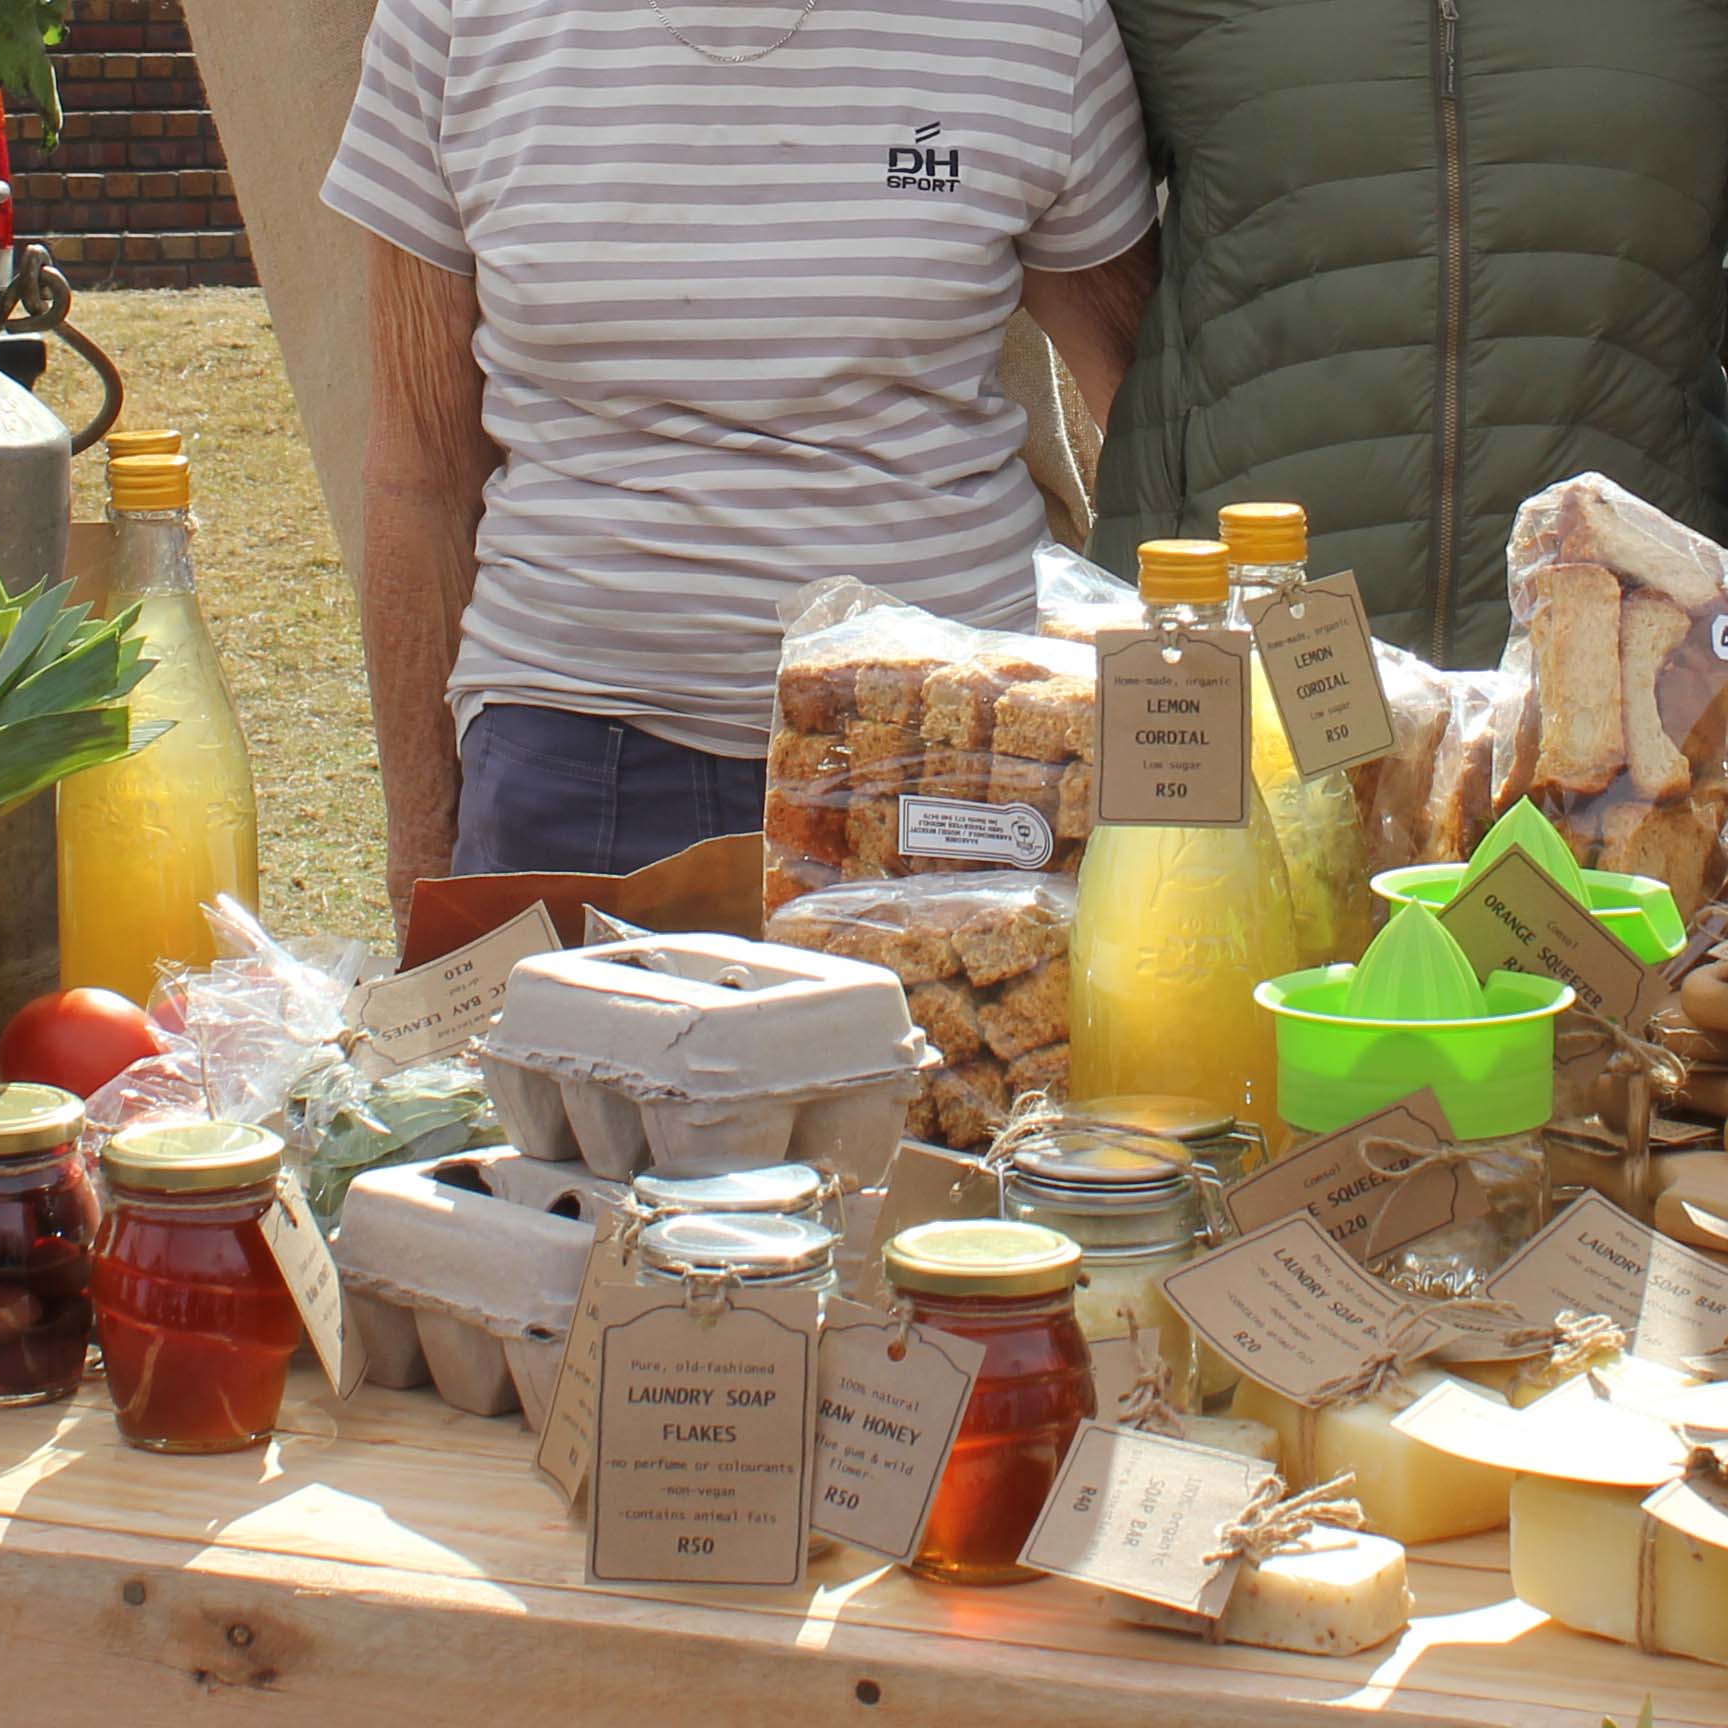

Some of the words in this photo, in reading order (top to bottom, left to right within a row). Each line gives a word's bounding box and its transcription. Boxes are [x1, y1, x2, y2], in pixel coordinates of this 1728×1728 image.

[887, 148, 960, 178] DH
[886, 175, 961, 193] SPORT
[1294, 645, 1334, 669] LEMON
[1296, 672, 1351, 701] CORDIAL
[1146, 698, 1201, 714] LEMON
[1135, 729, 1211, 746] CORDIAL
[1325, 724, 1350, 744] R50
[1169, 761, 1202, 772] sugar
[1155, 782, 1188, 799] R50
[1483, 893, 1537, 947] ORANGE
[1536, 945, 1604, 1010] SQUEEZER
[444, 959, 474, 981] R10
[381, 1012, 443, 1043] LEAVES
[452, 994, 482, 1017] BAY
[1303, 1162, 1342, 1189] Consol
[1576, 1231, 1648, 1277] LAUNDRY
[1647, 1274, 1692, 1299] SOAP
[1694, 1294, 1728, 1317] BAR
[1272, 1247, 1328, 1300] LAUNDRY
[1327, 1300, 1365, 1328] SOAP
[1232, 1329, 1263, 1355] R20
[630, 1359, 668, 1373] Pure,
[675, 1359, 776, 1375] old-fashioned
[627, 1385, 714, 1406] LAUNDRY
[725, 1388, 777, 1408] SOAP
[872, 1389, 921, 1413] natural
[662, 1423, 737, 1443] FLAKES
[819, 1398, 856, 1424] RAW
[862, 1413, 922, 1448] HONEY
[633, 1457, 688, 1473] perfume
[694, 1461, 710, 1472] or
[717, 1459, 795, 1475] colourants
[883, 1459, 915, 1477] wild
[823, 1484, 861, 1511] R50
[1072, 1484, 1098, 1513] R40
[1142, 1476, 1167, 1514] SOAP
[693, 1509, 740, 1522] animal
[747, 1511, 777, 1524] fats
[676, 1535, 715, 1556] R50
[1124, 1518, 1148, 1549] BAR
